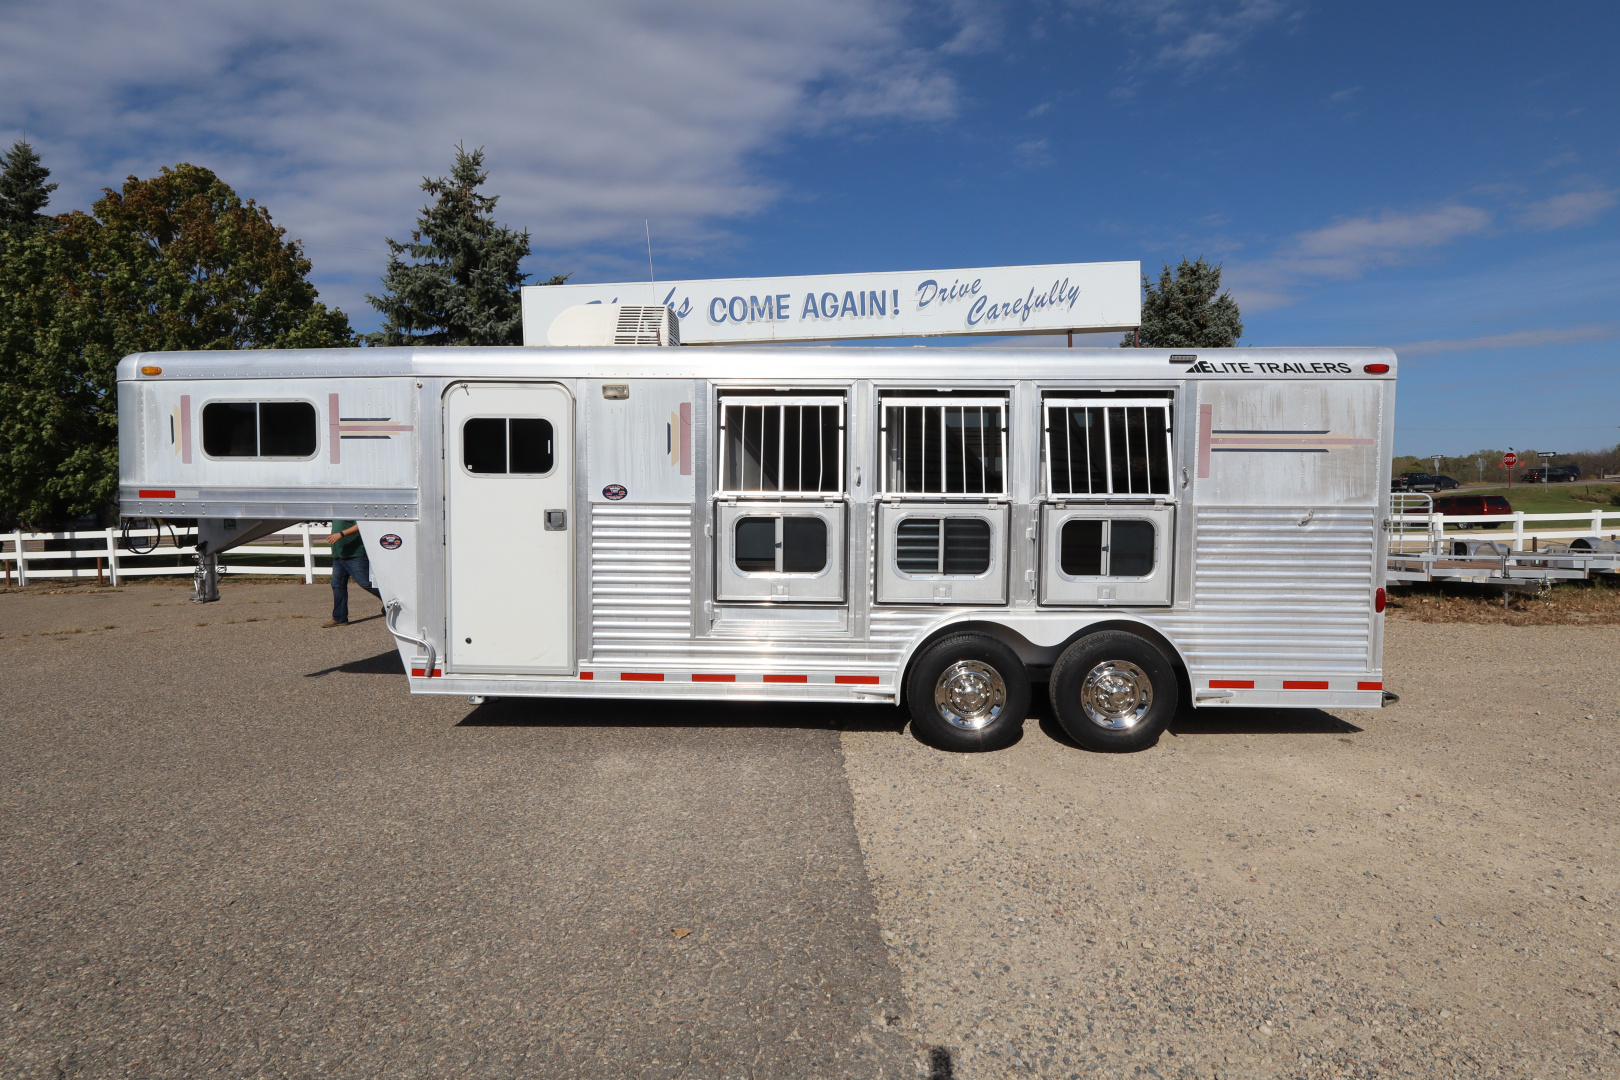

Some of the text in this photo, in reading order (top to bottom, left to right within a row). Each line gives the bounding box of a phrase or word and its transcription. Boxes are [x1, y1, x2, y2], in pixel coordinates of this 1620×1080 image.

[709, 297, 791, 324] COME
[801, 289, 900, 319] AGAIN!
[917, 278, 982, 308] Drive
[966, 277, 1081, 326] Carefully
[1186, 361, 1352, 373] ELITE TRAILERS
